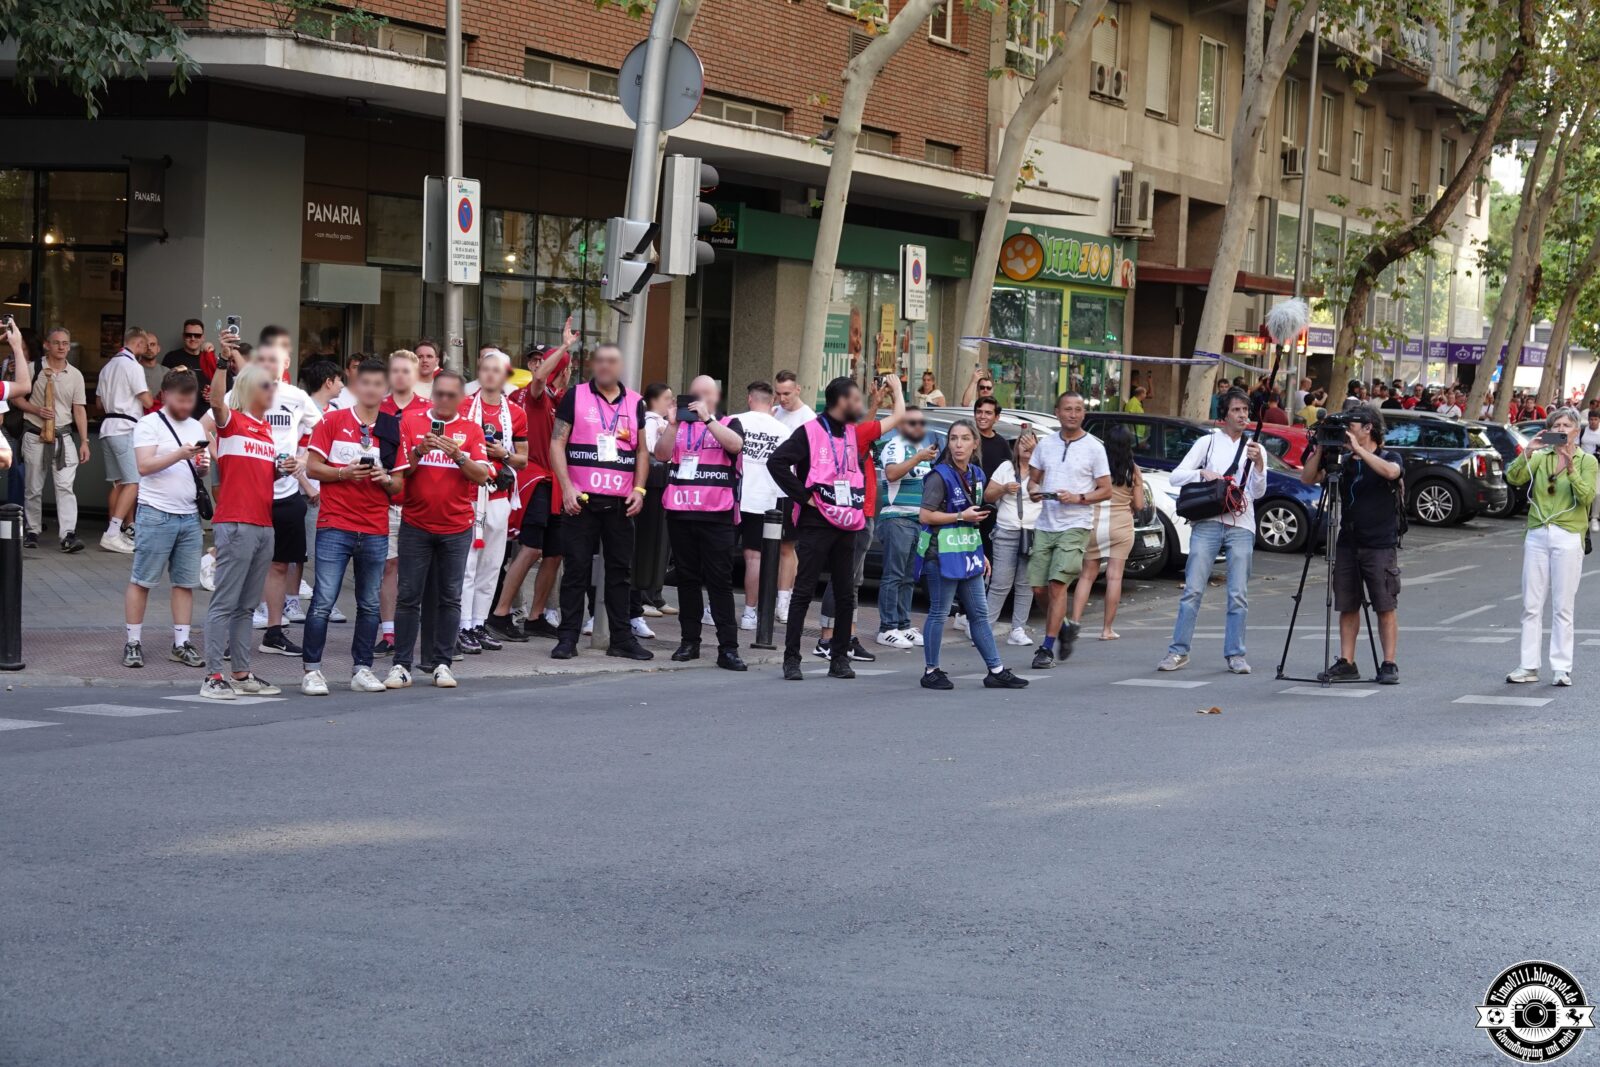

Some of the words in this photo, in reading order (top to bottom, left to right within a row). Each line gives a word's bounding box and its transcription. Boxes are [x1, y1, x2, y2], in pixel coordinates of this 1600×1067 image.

[134, 191, 161, 202] PANARIA
[307, 201, 362, 226] PANARIA
[266, 414, 291, 426] UMA
[743, 428, 780, 443] iveFast
[243, 441, 276, 459] WINAM
[569, 450, 598, 461] VISITING
[590, 472, 624, 491] 019
[695, 471, 729, 481] SUPPORT
[673, 490, 703, 506] 011
